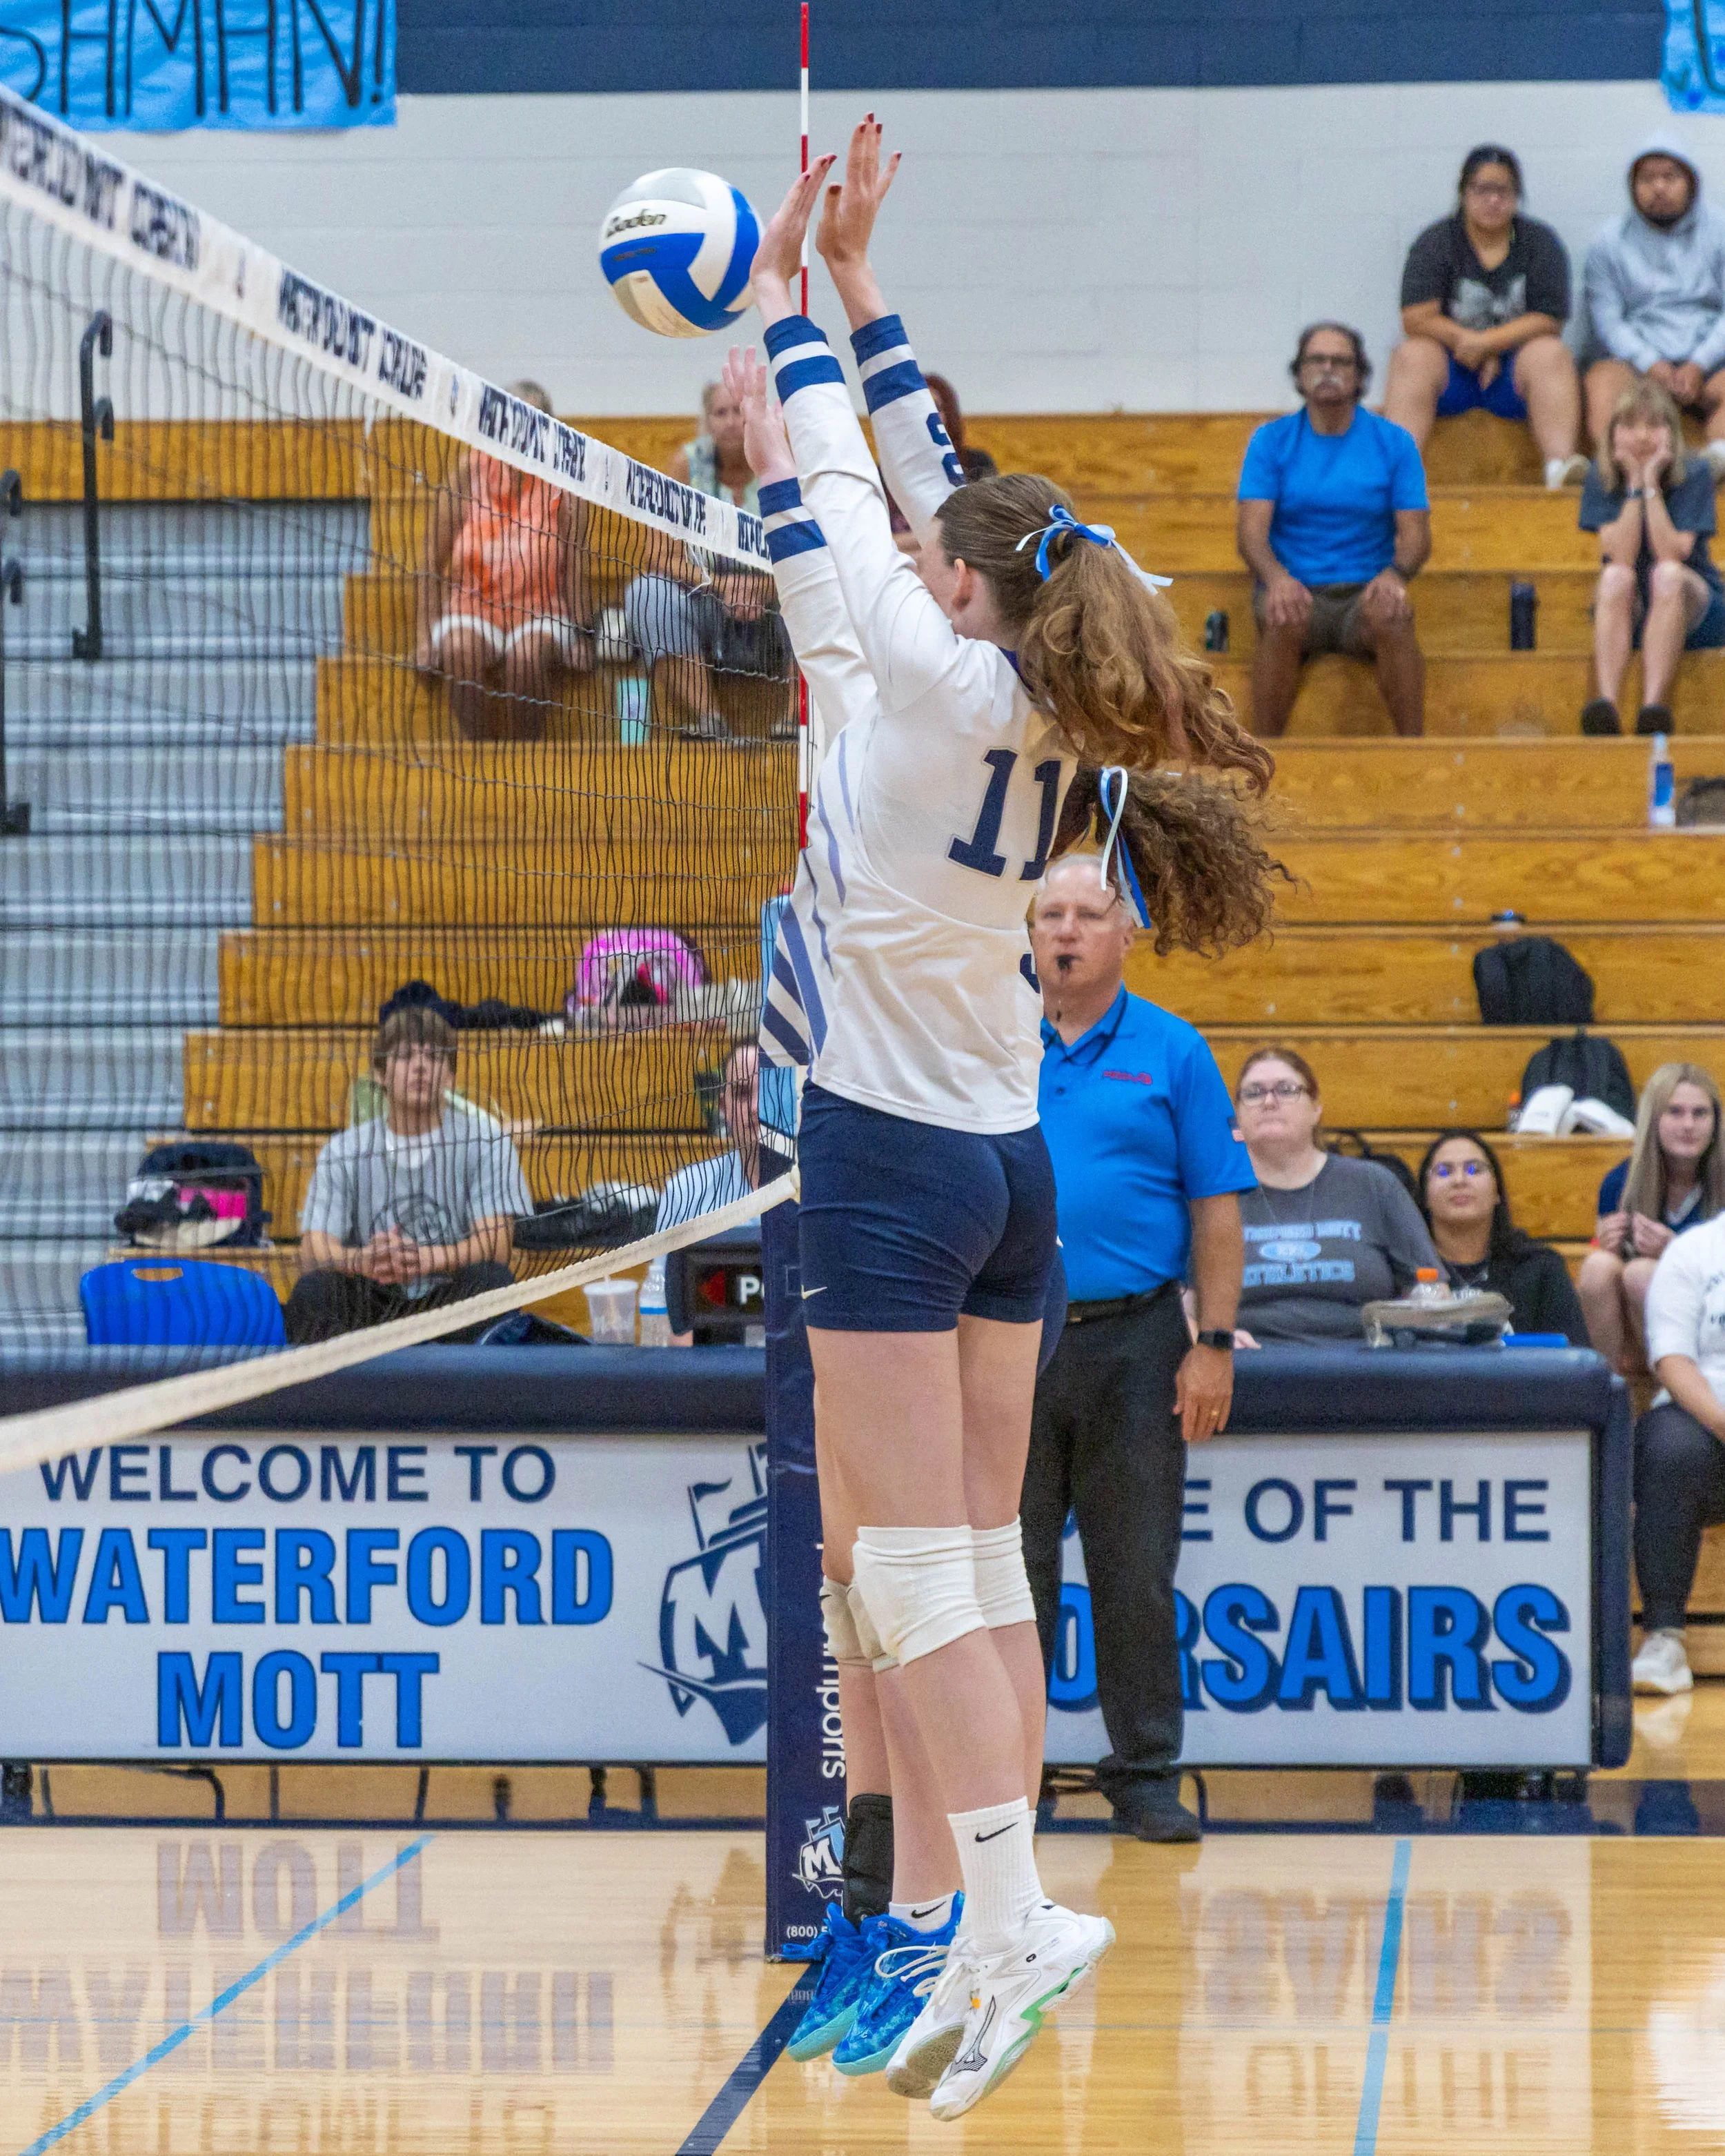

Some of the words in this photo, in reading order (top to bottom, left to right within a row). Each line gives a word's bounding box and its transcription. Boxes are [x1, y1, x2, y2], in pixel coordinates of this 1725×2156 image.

[947, 746, 1062, 881] 11
[40, 1445, 429, 1503] WELCOME
[454, 1445, 557, 1503] TO
[1244, 1479, 1358, 1543] OF
[1384, 1479, 1551, 1543] THE
[0, 1527, 614, 1627] WATERFORD
[1046, 1583, 1573, 1714] OSAIRS
[157, 1650, 440, 1750] MOTT
[816, 1643, 846, 1779] ports
[786, 1926, 818, 1939] (800)
